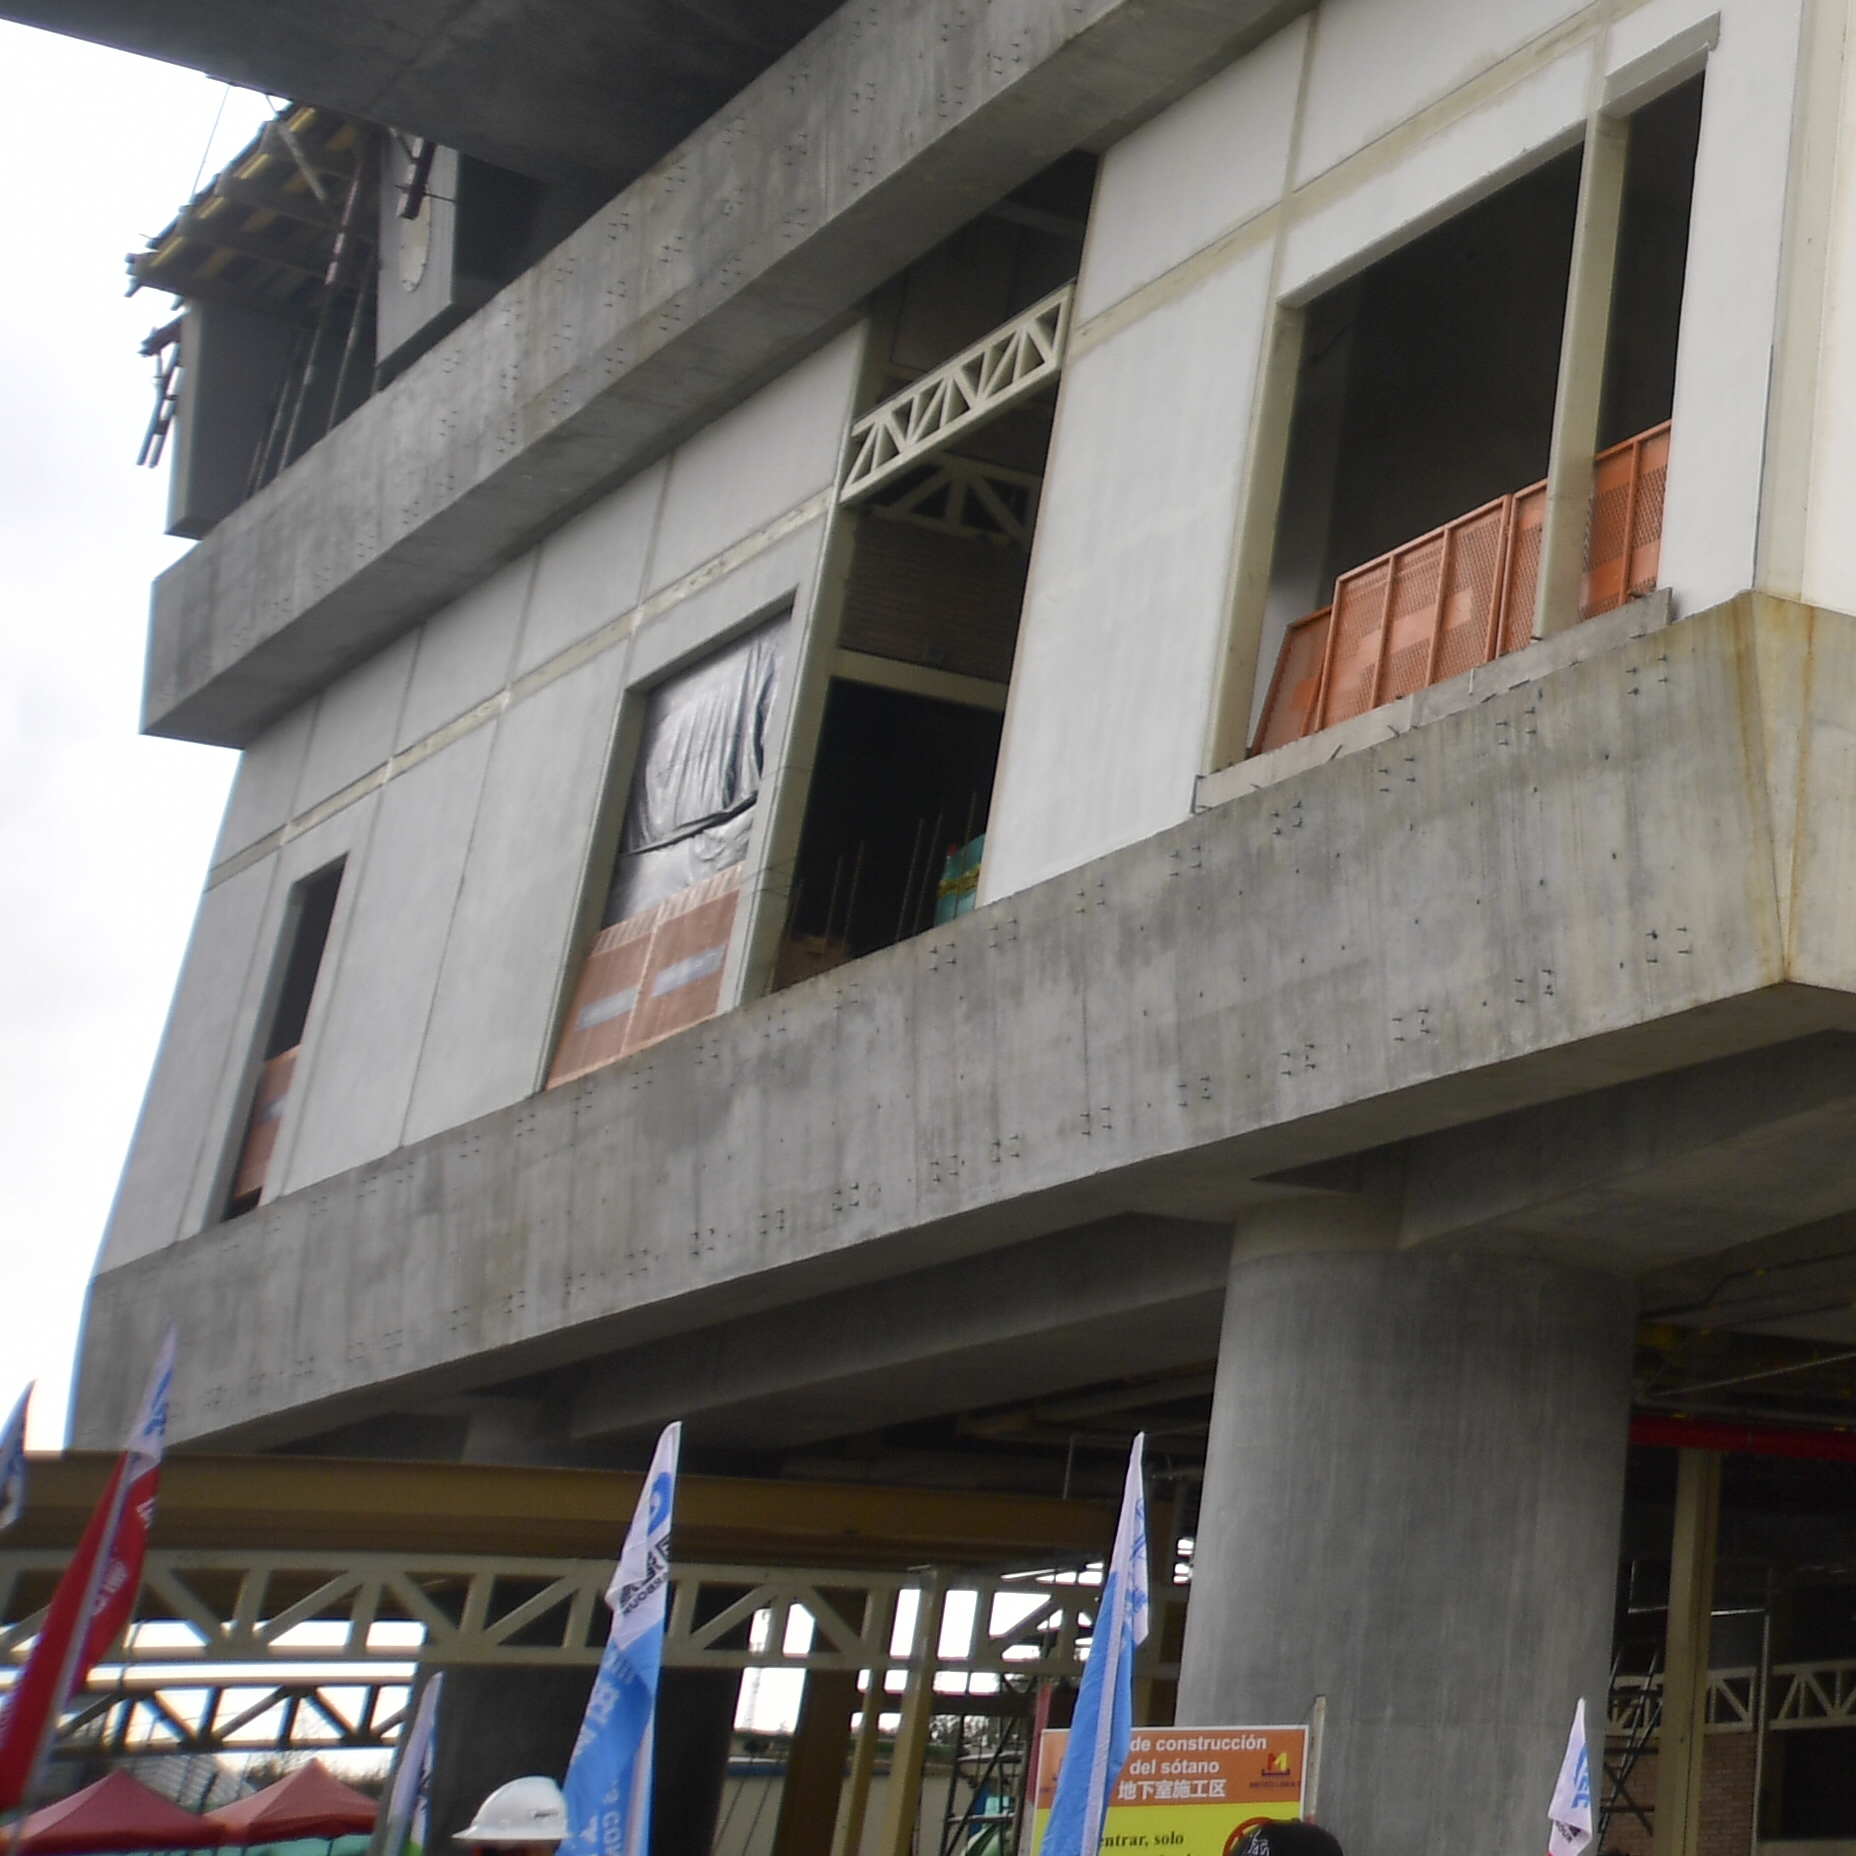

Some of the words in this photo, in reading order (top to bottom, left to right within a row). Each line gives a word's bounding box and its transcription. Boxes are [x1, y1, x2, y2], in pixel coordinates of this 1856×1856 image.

[1130, 1736, 1151, 1752] de
[1155, 1734, 1268, 1752] construcción
[1129, 1758, 1156, 1775] del
[1160, 1758, 1220, 1775] sótano
[1117, 1778, 1227, 1800] 地下室施工区
[1153, 1830, 1184, 1845] solo
